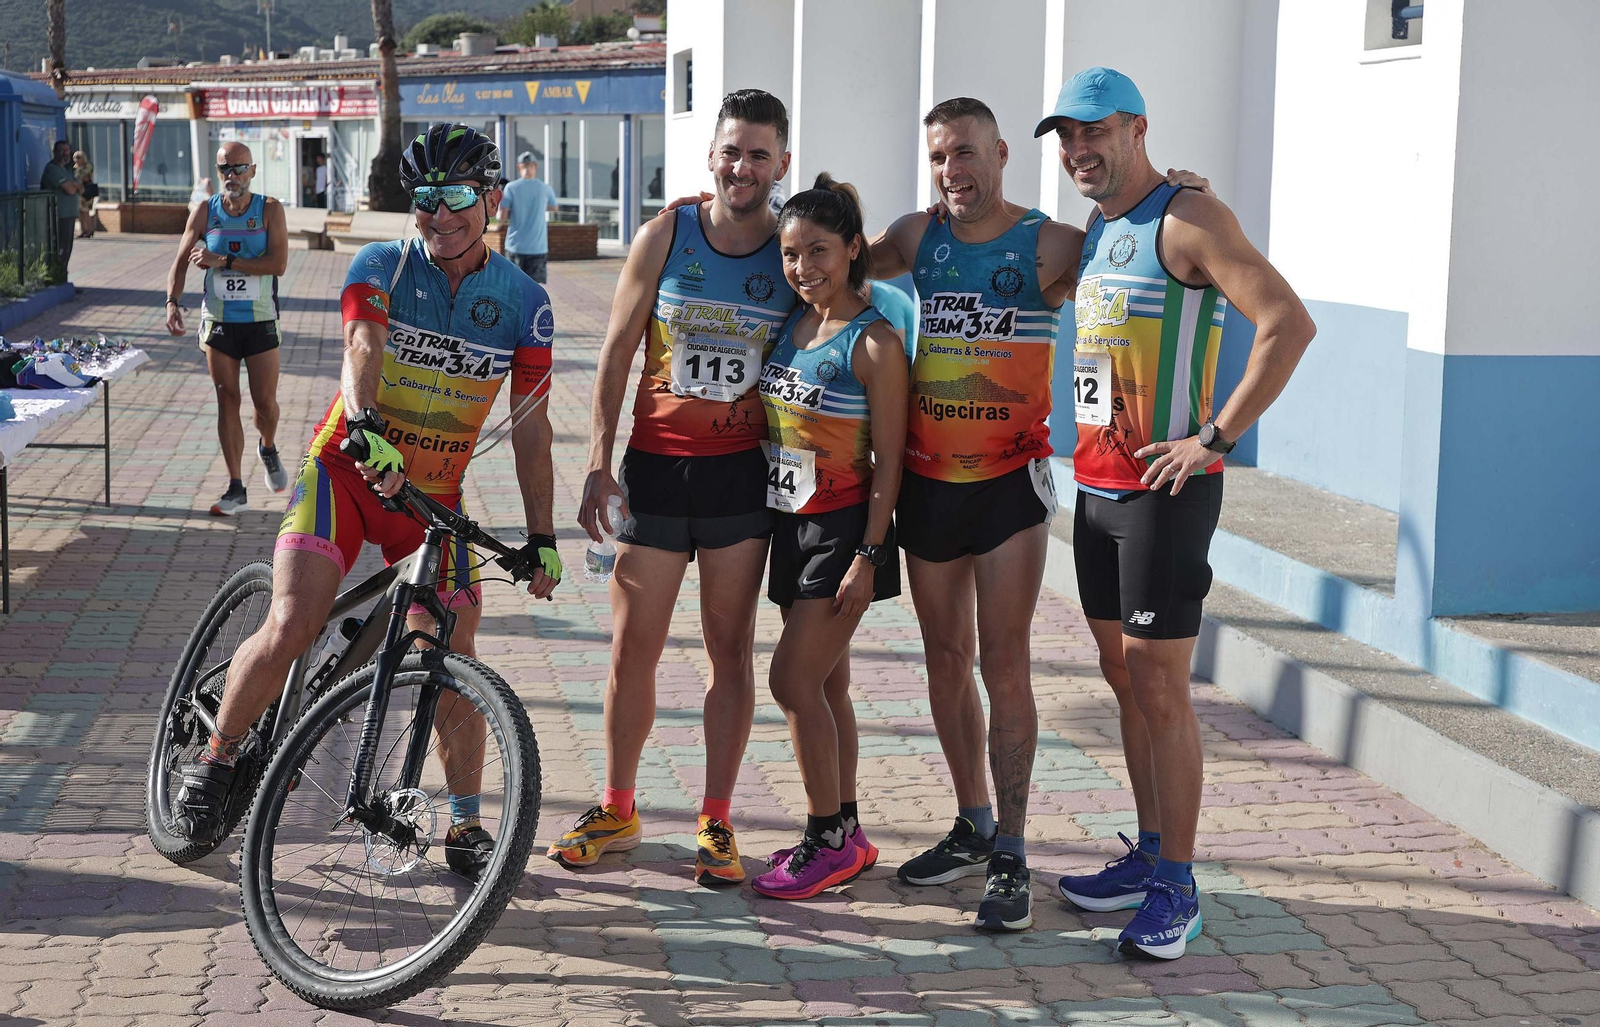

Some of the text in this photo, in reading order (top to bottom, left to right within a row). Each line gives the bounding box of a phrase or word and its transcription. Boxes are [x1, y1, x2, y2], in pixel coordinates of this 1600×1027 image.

[541, 86, 574, 98] AMBAR
[226, 279, 246, 291] 82
[684, 304, 735, 322] TRAIL
[934, 296, 978, 314] TRAIL
[925, 311, 1014, 338] TEAM 3x4
[416, 332, 461, 353] TRAIL
[687, 337, 747, 349] CARRERA URBANA
[687, 343, 747, 356] CIUDAD DE ALGECIRAS
[1094, 335, 1130, 347] Servicios
[929, 343, 1012, 358] Gabarras & Servicios
[400, 348, 492, 379] TEAM 3x4
[686, 354, 745, 384] 113
[765, 365, 797, 382] TRAIL
[399, 376, 488, 402] Gabarras & Servicios
[782, 383, 821, 407] 3x4
[789, 408, 818, 423] Servicios
[918, 395, 1010, 421] Algeciras
[382, 420, 471, 453] lgeciras
